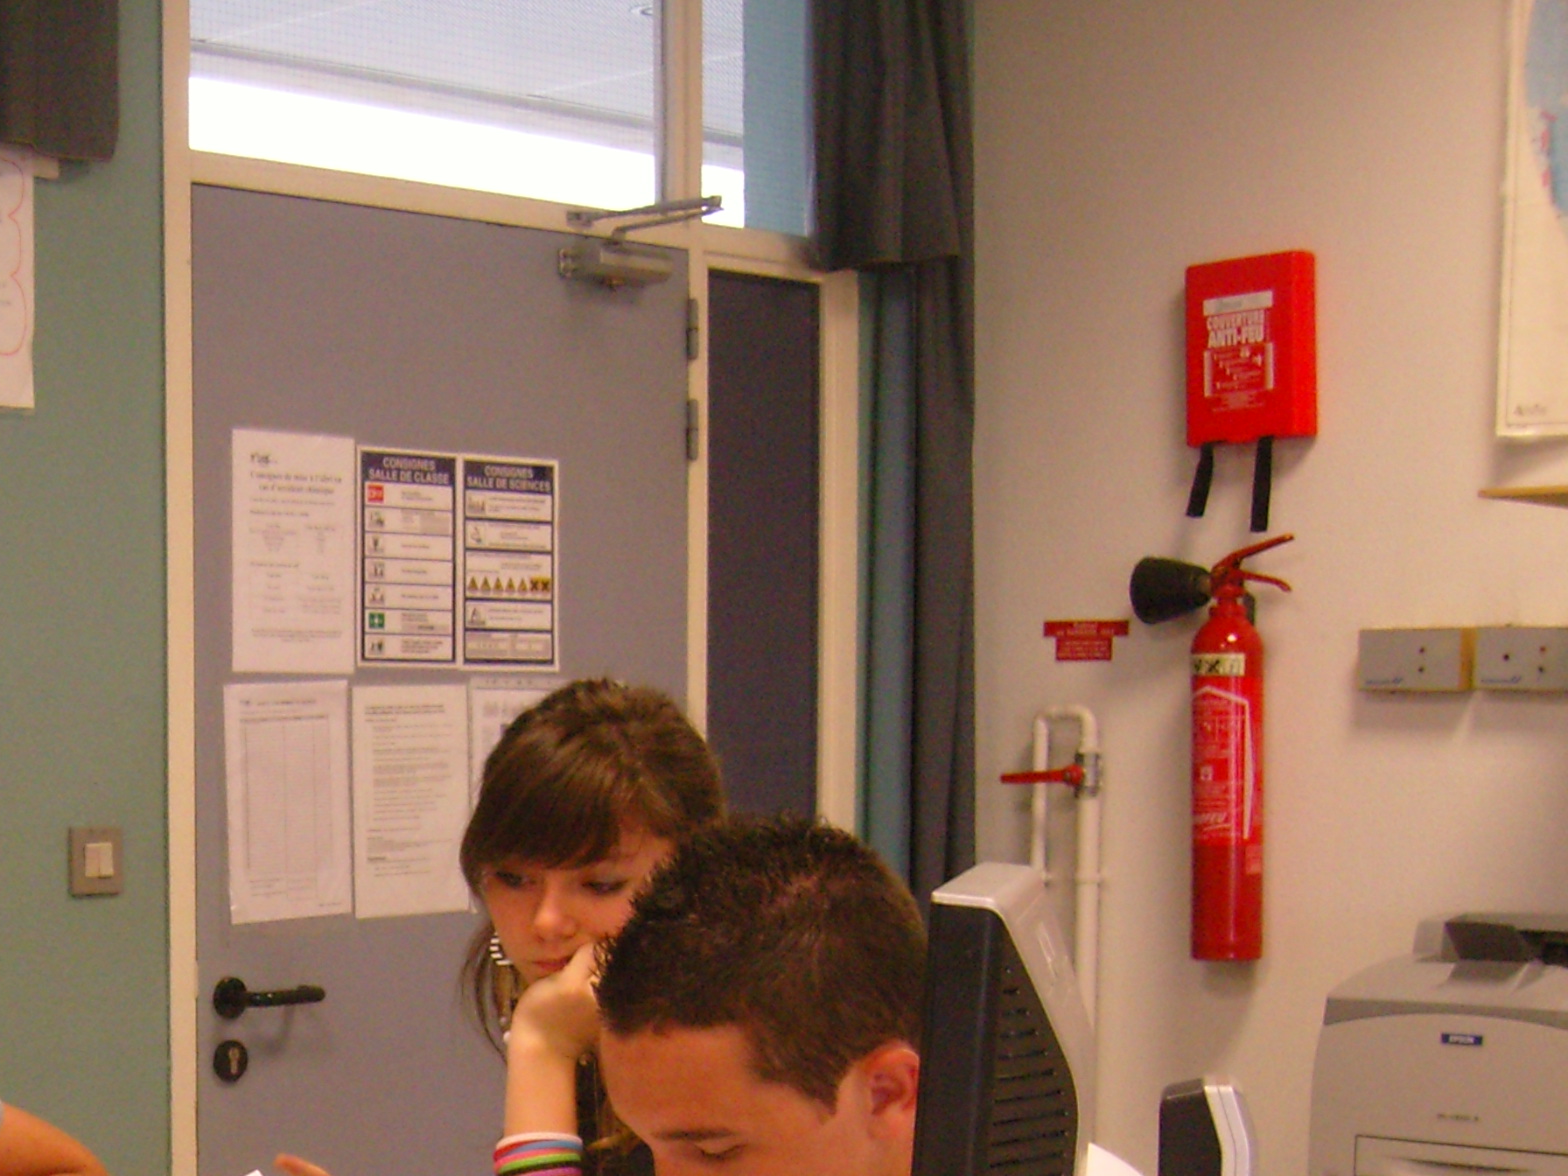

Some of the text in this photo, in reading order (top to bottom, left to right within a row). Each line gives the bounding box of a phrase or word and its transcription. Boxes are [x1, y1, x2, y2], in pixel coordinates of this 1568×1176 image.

[1207, 324, 1265, 348] ANTI-FEU
[383, 457, 436, 470] CONSIGNES
[368, 468, 450, 485] SALLE DE CLASSE
[484, 465, 534, 479] CONSIGNES
[467, 476, 551, 492] SALLE DE SCIENCES
